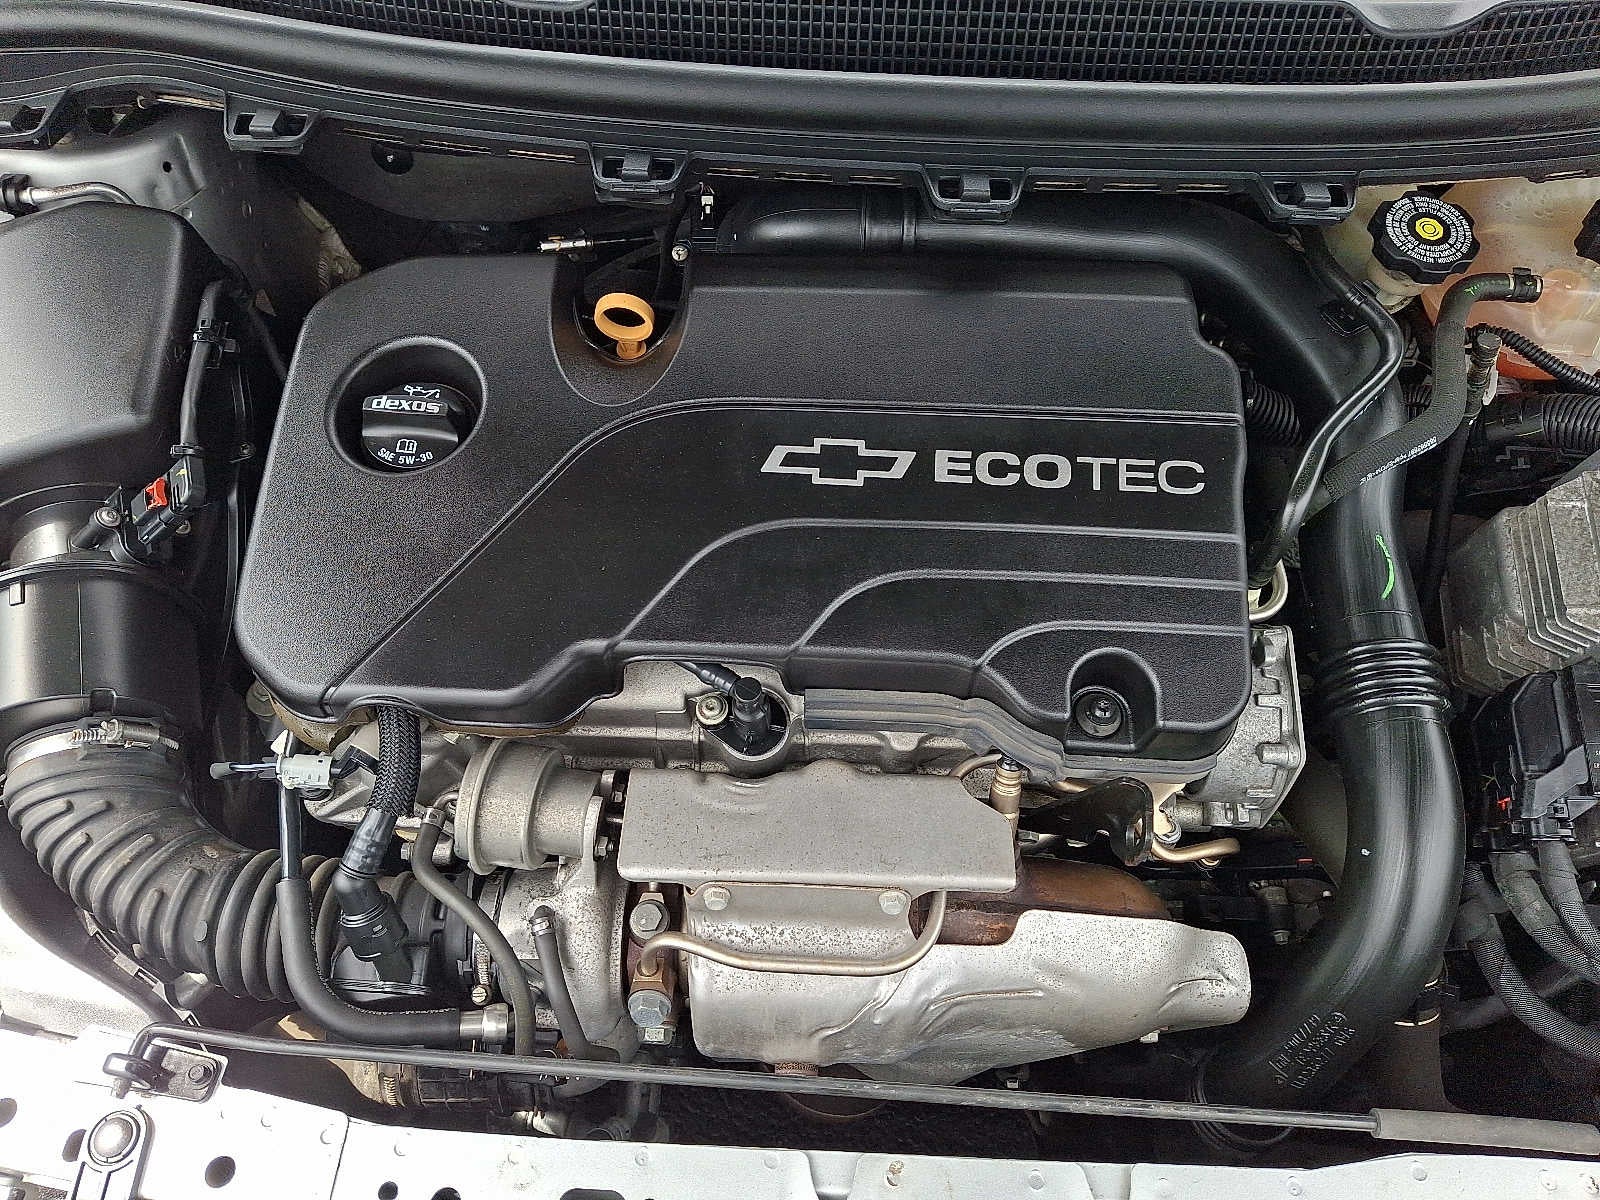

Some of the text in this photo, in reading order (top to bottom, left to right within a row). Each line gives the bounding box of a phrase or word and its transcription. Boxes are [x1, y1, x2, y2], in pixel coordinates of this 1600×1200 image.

[371, 395, 443, 413] dexos
[377, 447, 434, 465] SAE 5W-30
[934, 449, 1205, 495] ECOTEC
